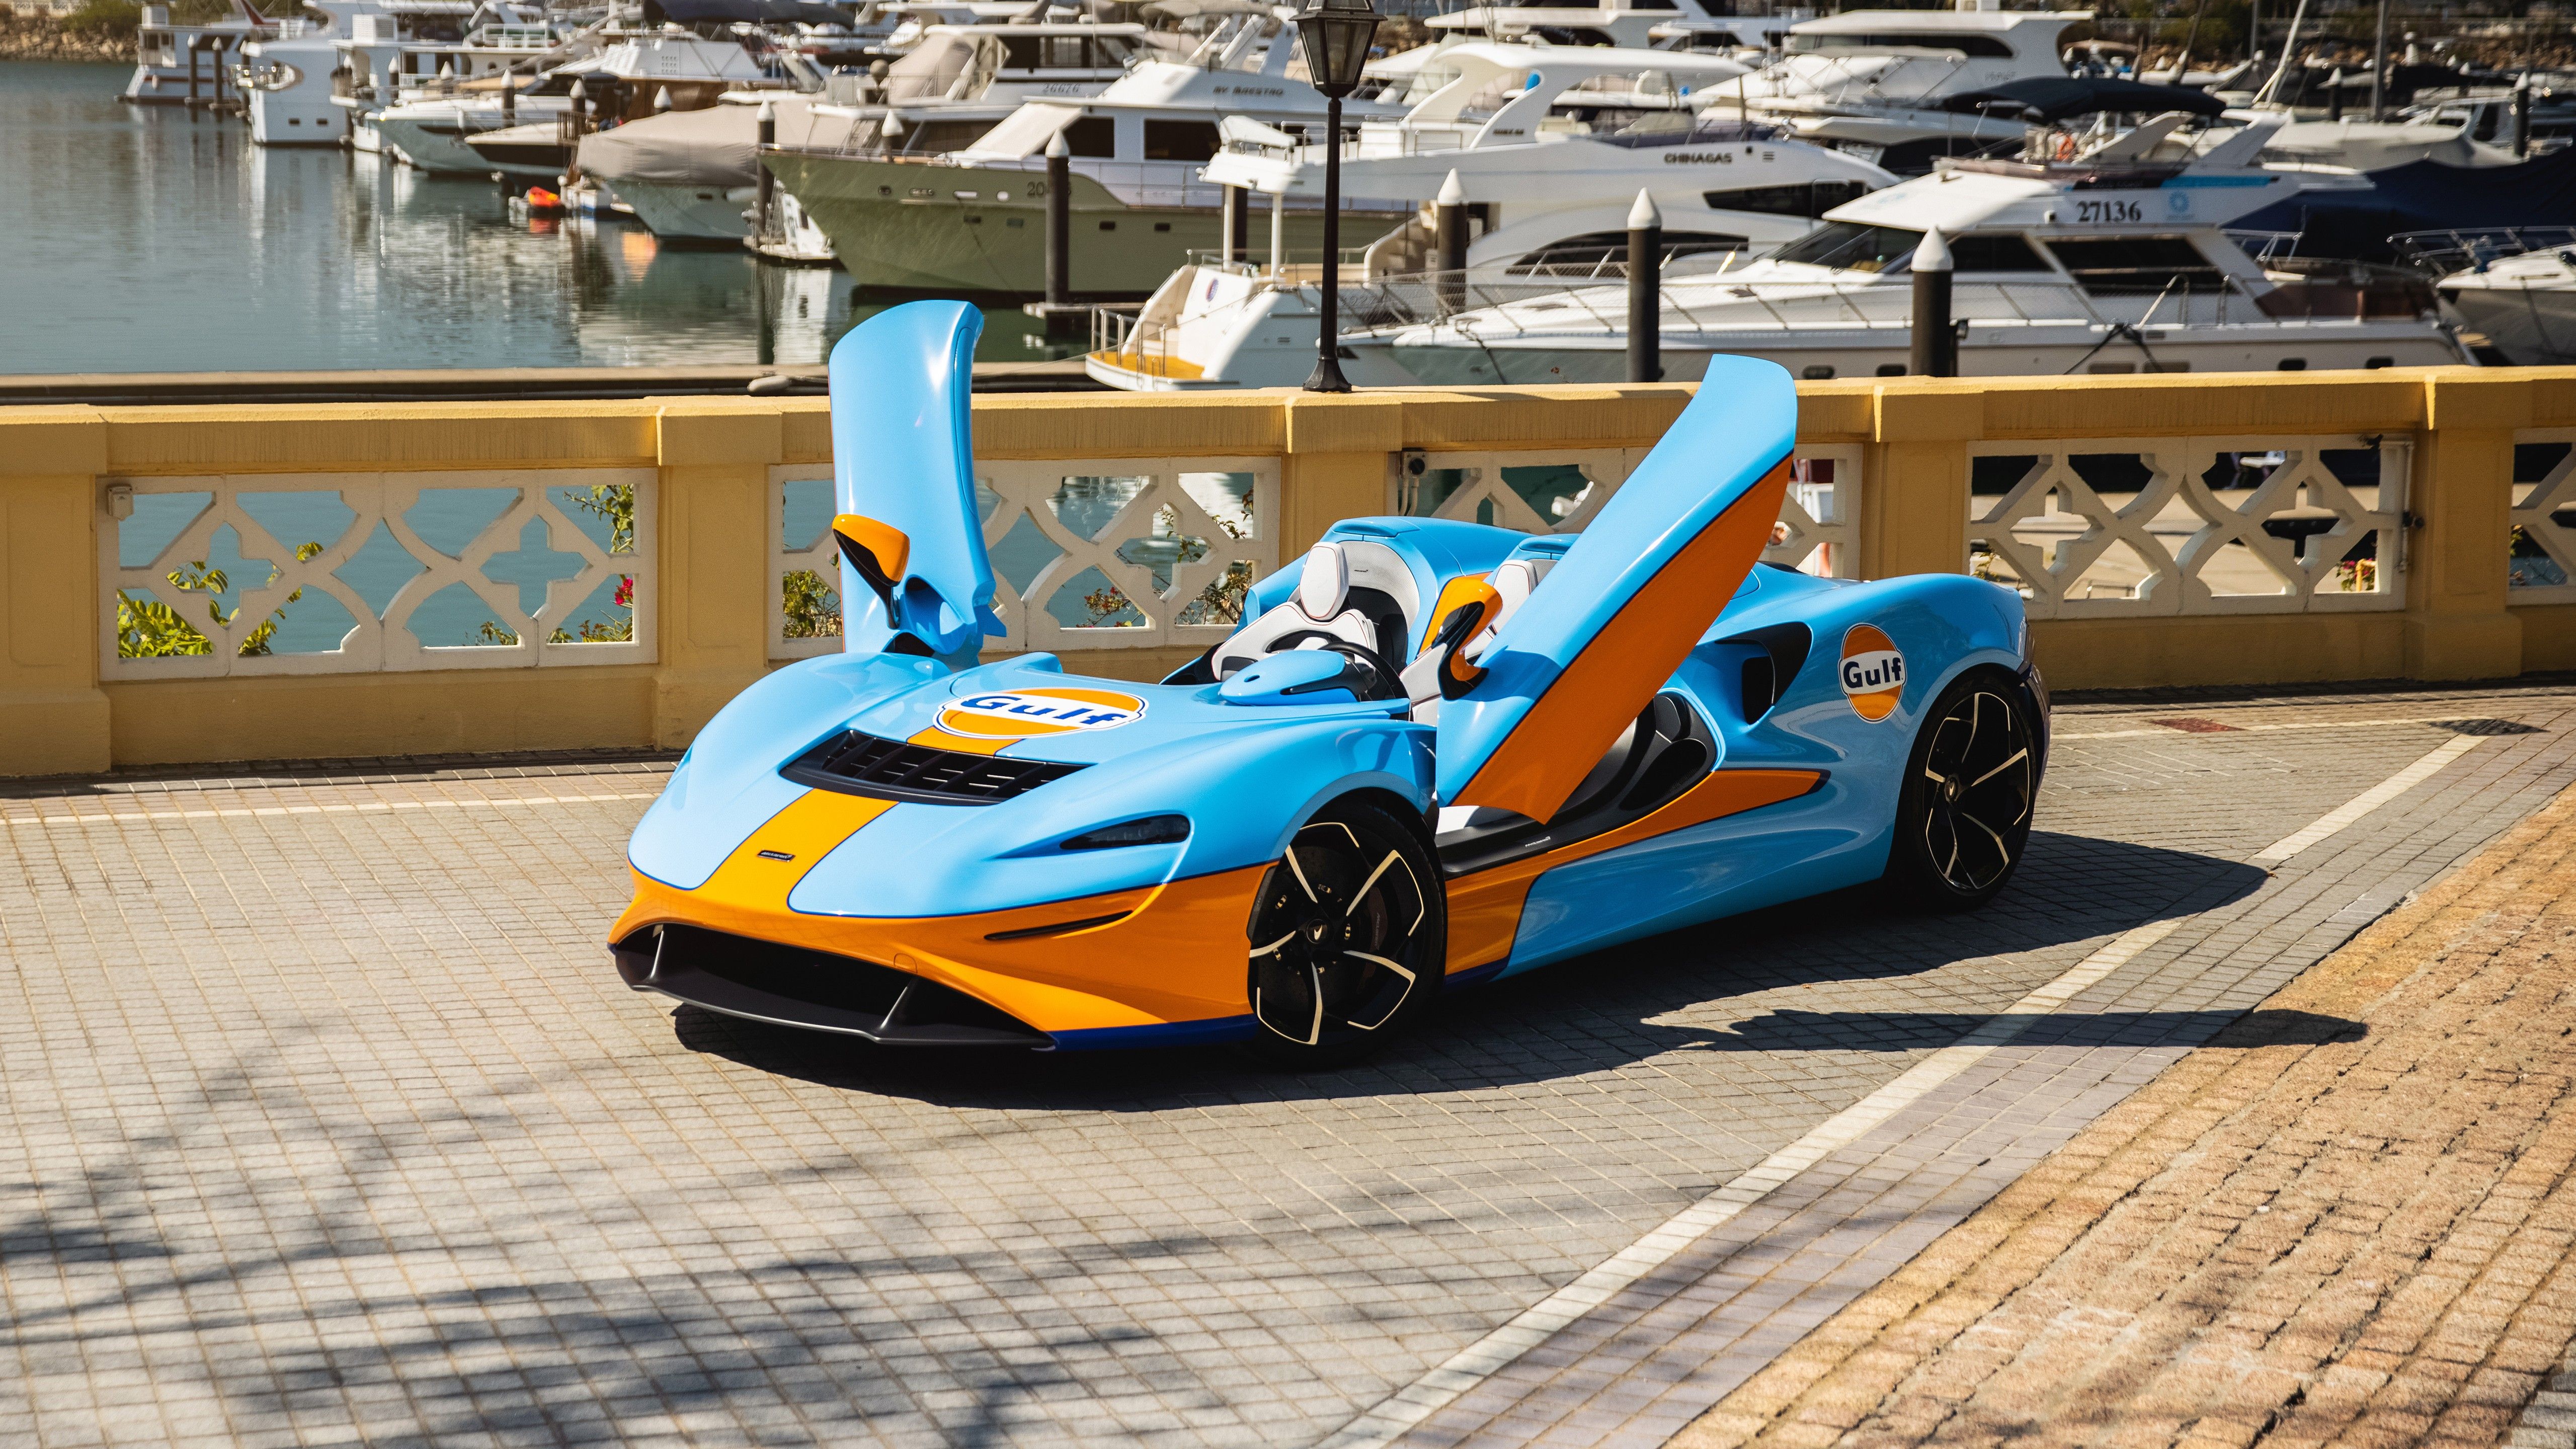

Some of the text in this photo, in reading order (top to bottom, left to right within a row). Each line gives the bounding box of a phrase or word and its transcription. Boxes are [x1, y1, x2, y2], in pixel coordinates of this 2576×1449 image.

[1664, 152, 1732, 164] CHINAGAS
[2077, 201, 2142, 222] 27136
[1843, 657, 1901, 688] Gulf
[960, 696, 1128, 725] Gulf
